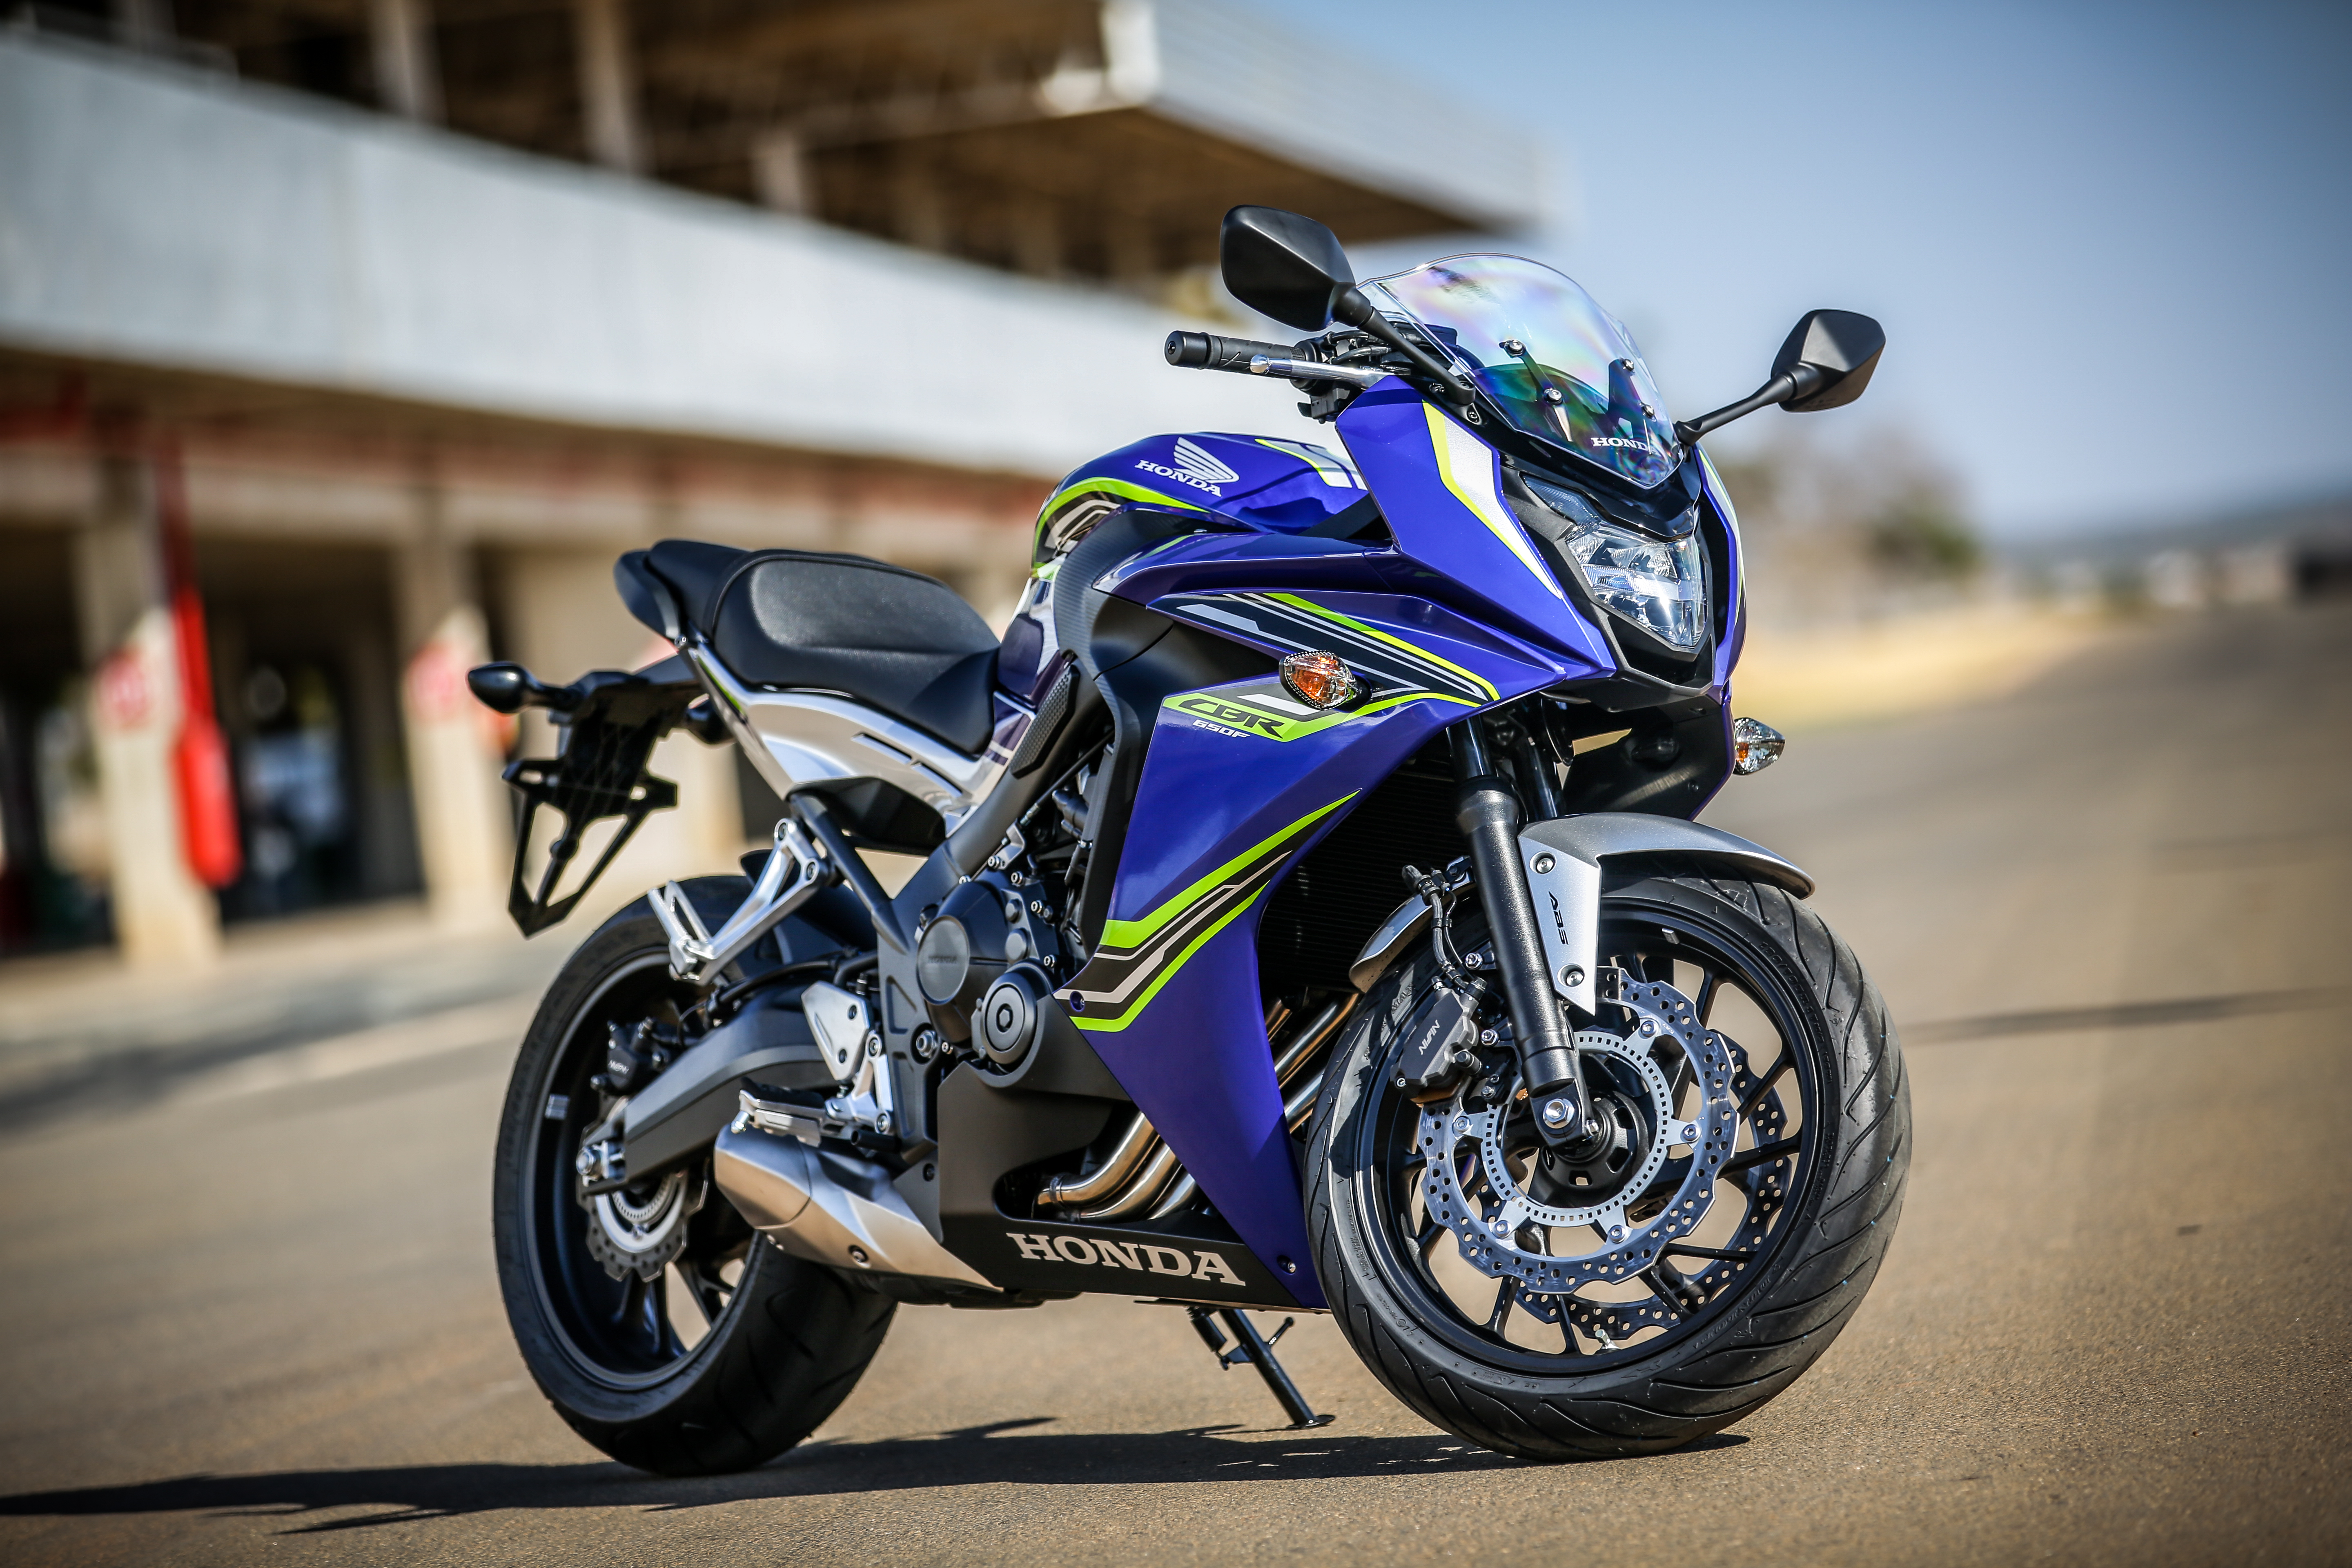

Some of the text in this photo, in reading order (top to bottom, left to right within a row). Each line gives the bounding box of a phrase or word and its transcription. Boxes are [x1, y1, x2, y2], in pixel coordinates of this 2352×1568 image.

[1134, 459, 1222, 497] HONDA
[1178, 698, 1285, 739] CBR
[1192, 719, 1250, 738] 650F
[1548, 891, 1569, 945] ABS
[1006, 1232, 1246, 1286] HONDA
